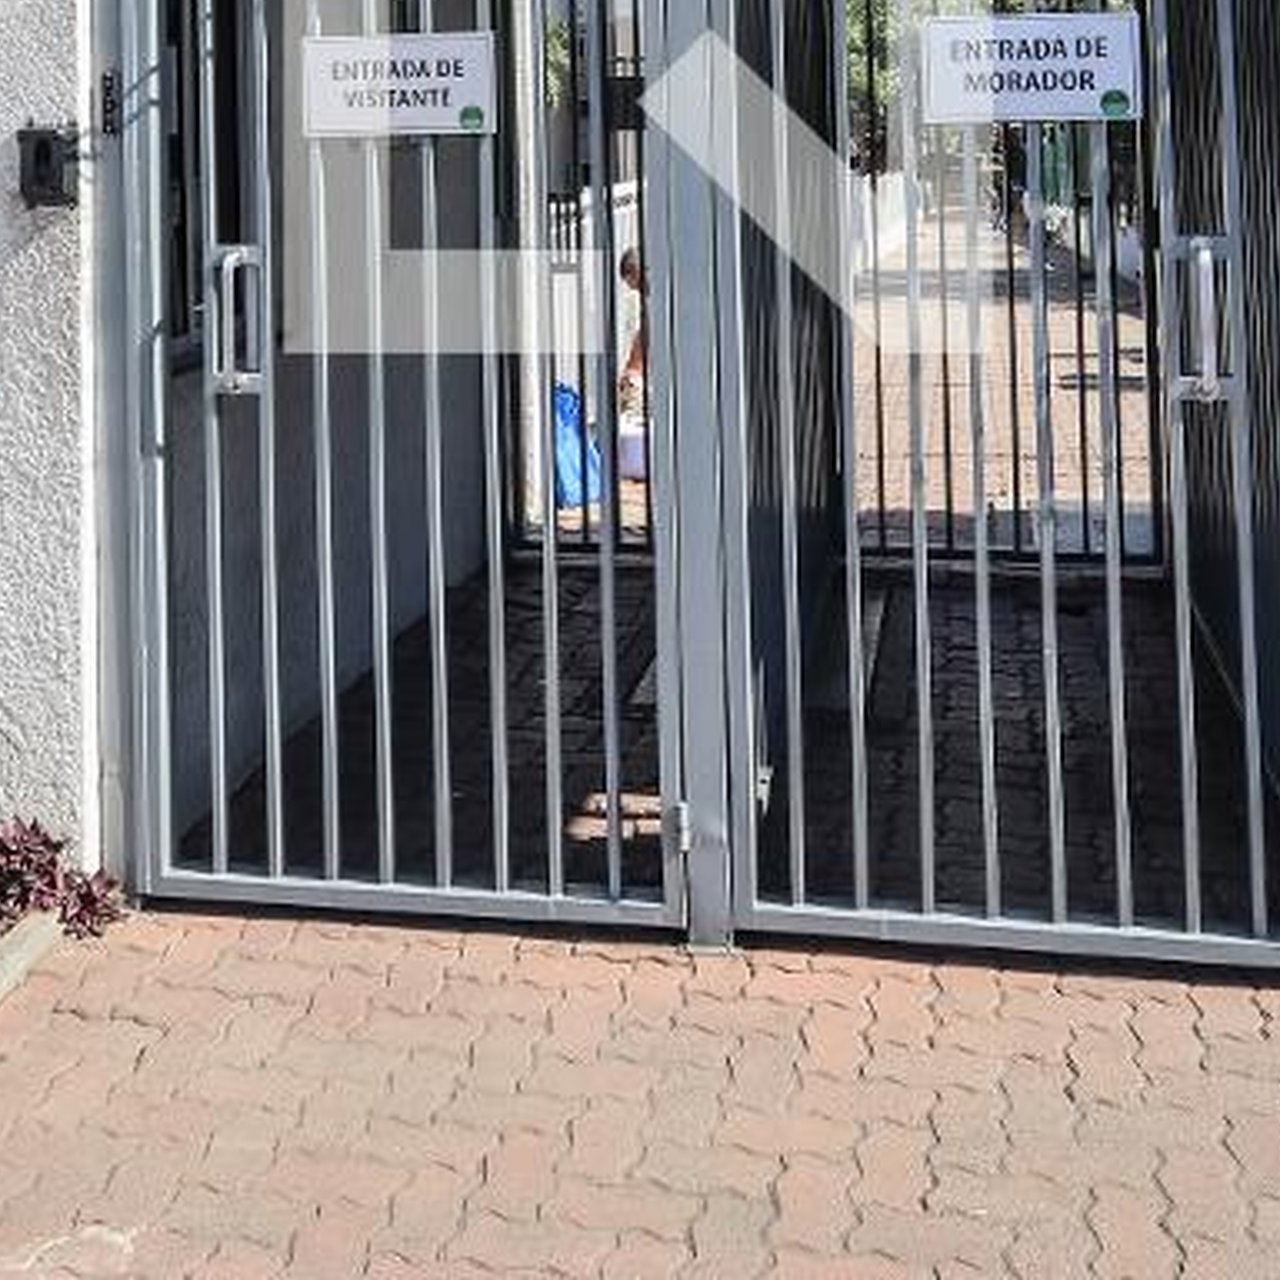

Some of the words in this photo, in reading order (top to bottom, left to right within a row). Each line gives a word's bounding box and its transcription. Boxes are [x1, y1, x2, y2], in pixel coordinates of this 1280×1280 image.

[951, 37, 1068, 61] ENTRADA
[1075, 36, 1108, 58] DE
[332, 59, 431, 80] ENTRADA
[436, 58, 464, 78] DE
[963, 70, 1096, 93] MORADOR
[345, 87, 453, 108] VISITANTE
